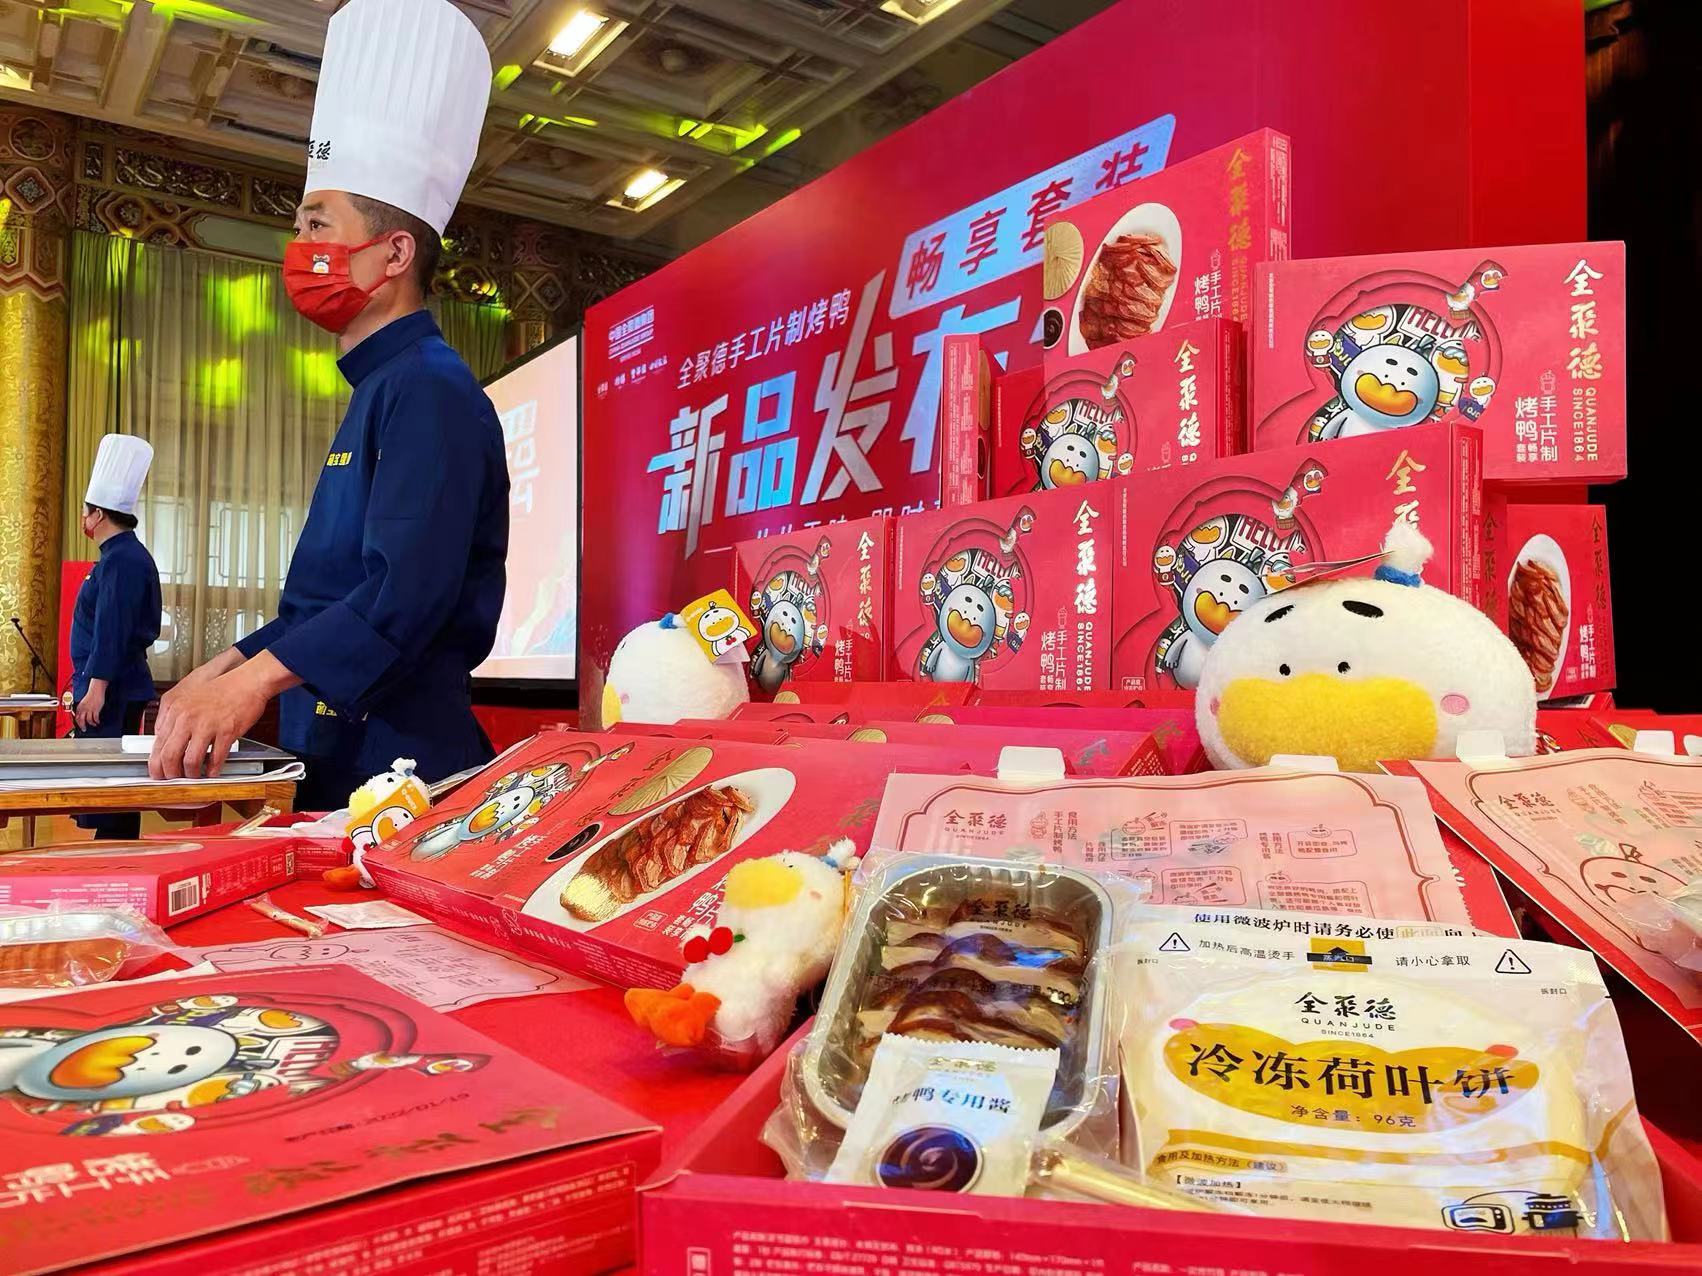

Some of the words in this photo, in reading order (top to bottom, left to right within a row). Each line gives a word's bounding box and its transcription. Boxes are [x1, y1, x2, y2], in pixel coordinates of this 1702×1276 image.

[1226, 147, 1251, 251] 全聚德
[1194, 273, 1210, 315] 烤鸭
[1210, 269, 1222, 319] 手工片
[1564, 258, 1604, 380] 全聚德
[677, 288, 851, 390] 全聚德手工片制烤鸭
[1174, 339, 1200, 447] 全聚德
[1515, 396, 1539, 442] 烤鸭
[1539, 395, 1559, 462] 手工片制
[1572, 388, 1585, 463] SINCE1864
[1585, 387, 1599, 462] QUANJUDE
[1073, 499, 1100, 614] 全聚德
[1040, 631, 1057, 673] 烤鸭
[1084, 621, 1094, 691] QUANJUDE
[944, 809, 1008, 829] 全聚德
[1067, 811, 1077, 840] 食用方法
[1199, 939, 1296, 961] 加热后高温烫手
[1395, 955, 1471, 968] 请小心拿取
[1293, 991, 1397, 1021] 全聚德
[1301, 1017, 1396, 1032] QUANJUDE
[1320, 1029, 1375, 1039] SINCE1864
[1186, 1043, 1516, 1105] 冷冻荷叶饼
